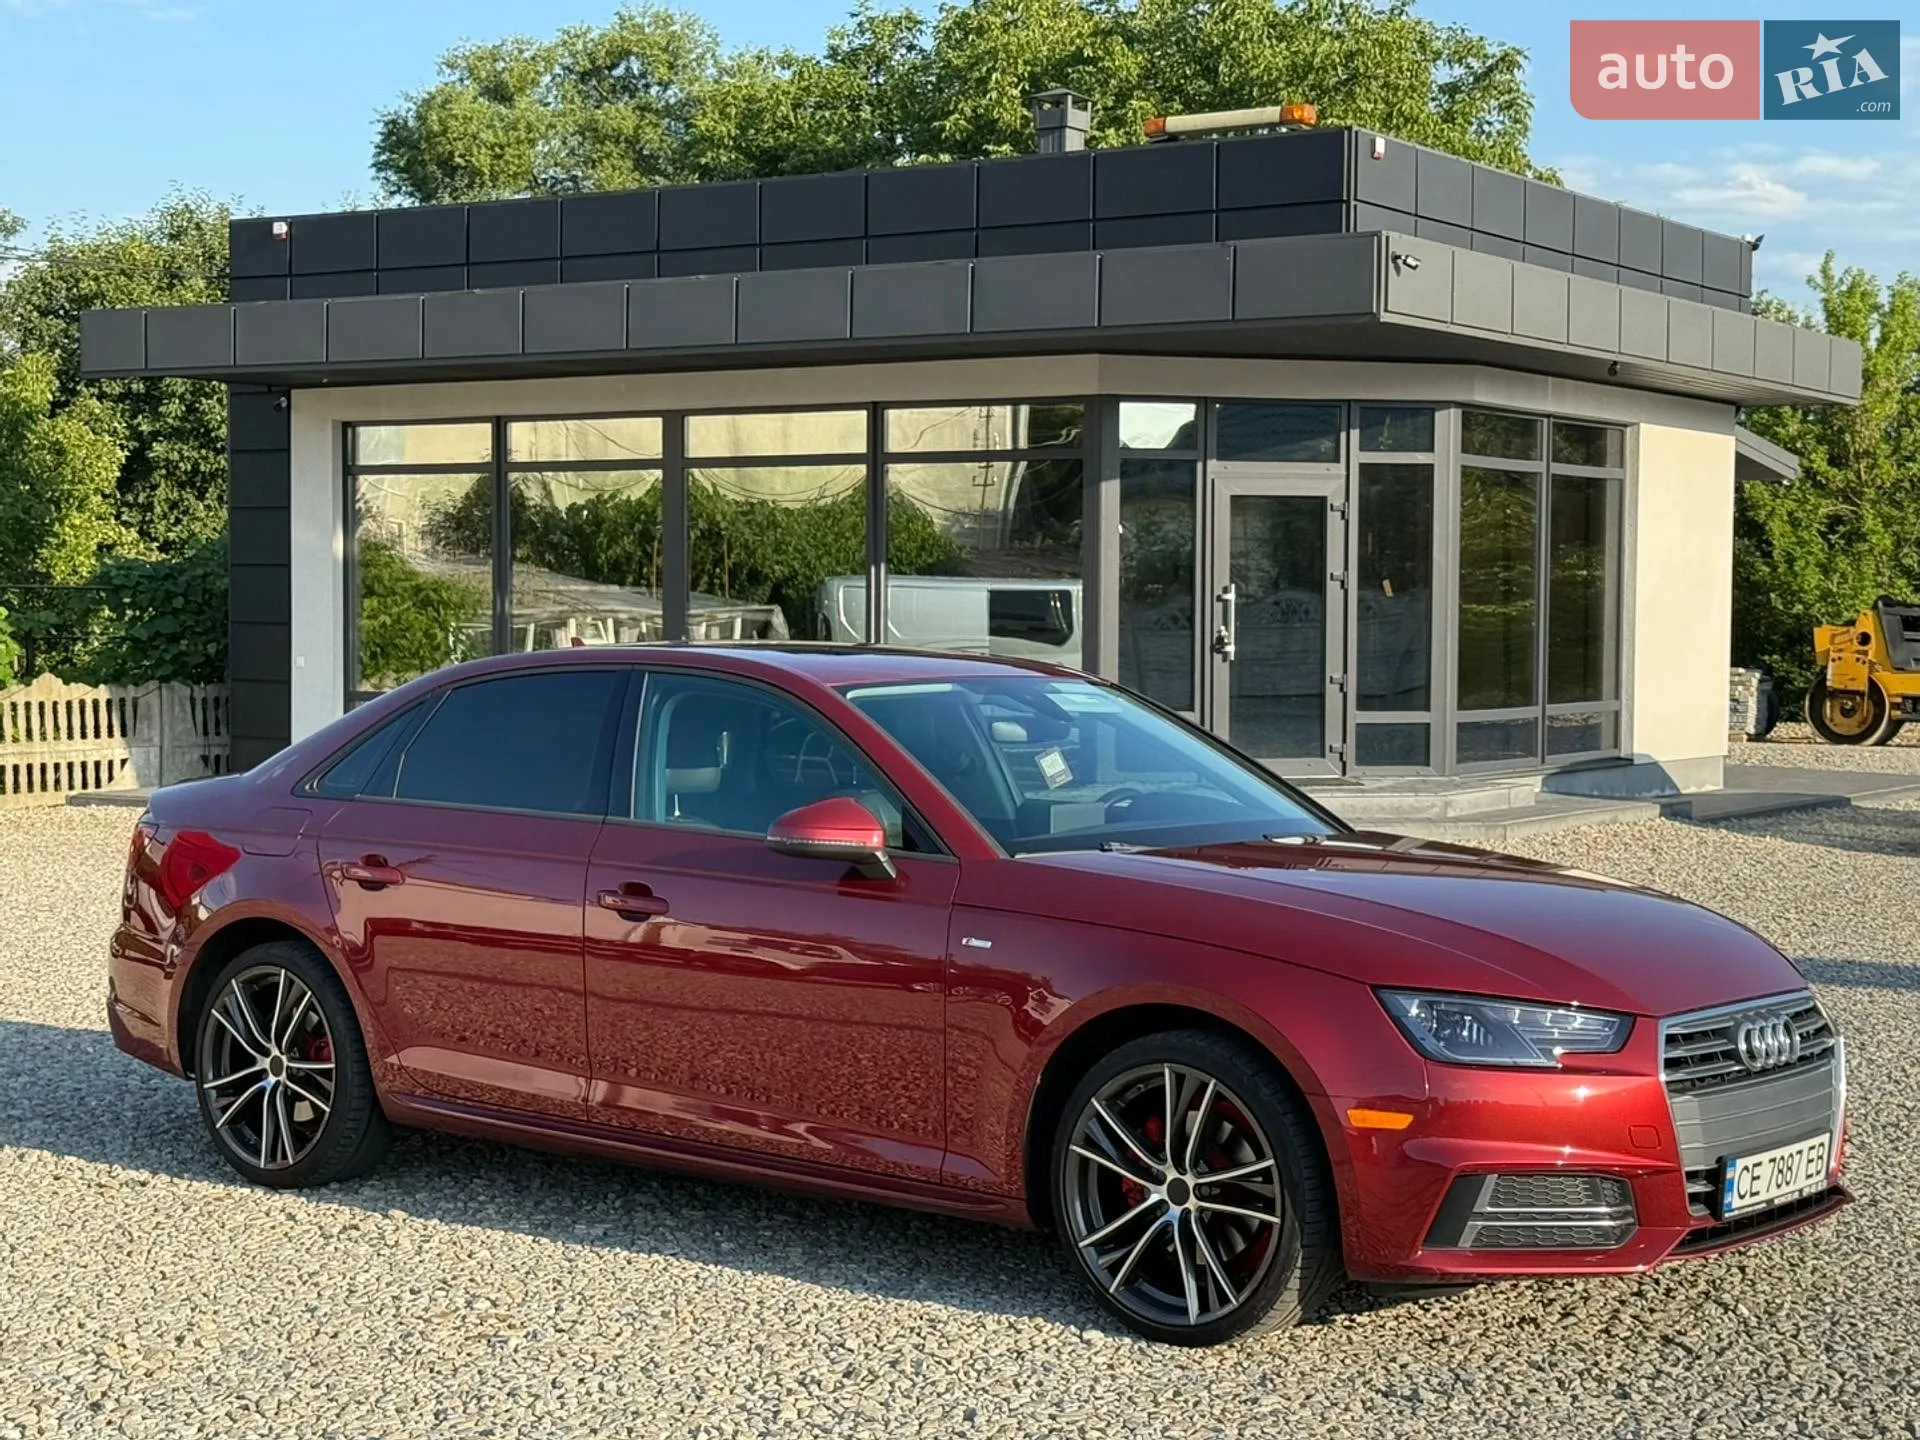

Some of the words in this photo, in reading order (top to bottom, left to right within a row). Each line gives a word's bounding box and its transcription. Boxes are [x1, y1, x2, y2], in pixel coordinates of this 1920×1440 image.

[1737, 1161, 1762, 1200] CE
[1766, 1150, 1803, 1193] 7887
[1805, 1142, 1825, 1179] EB
